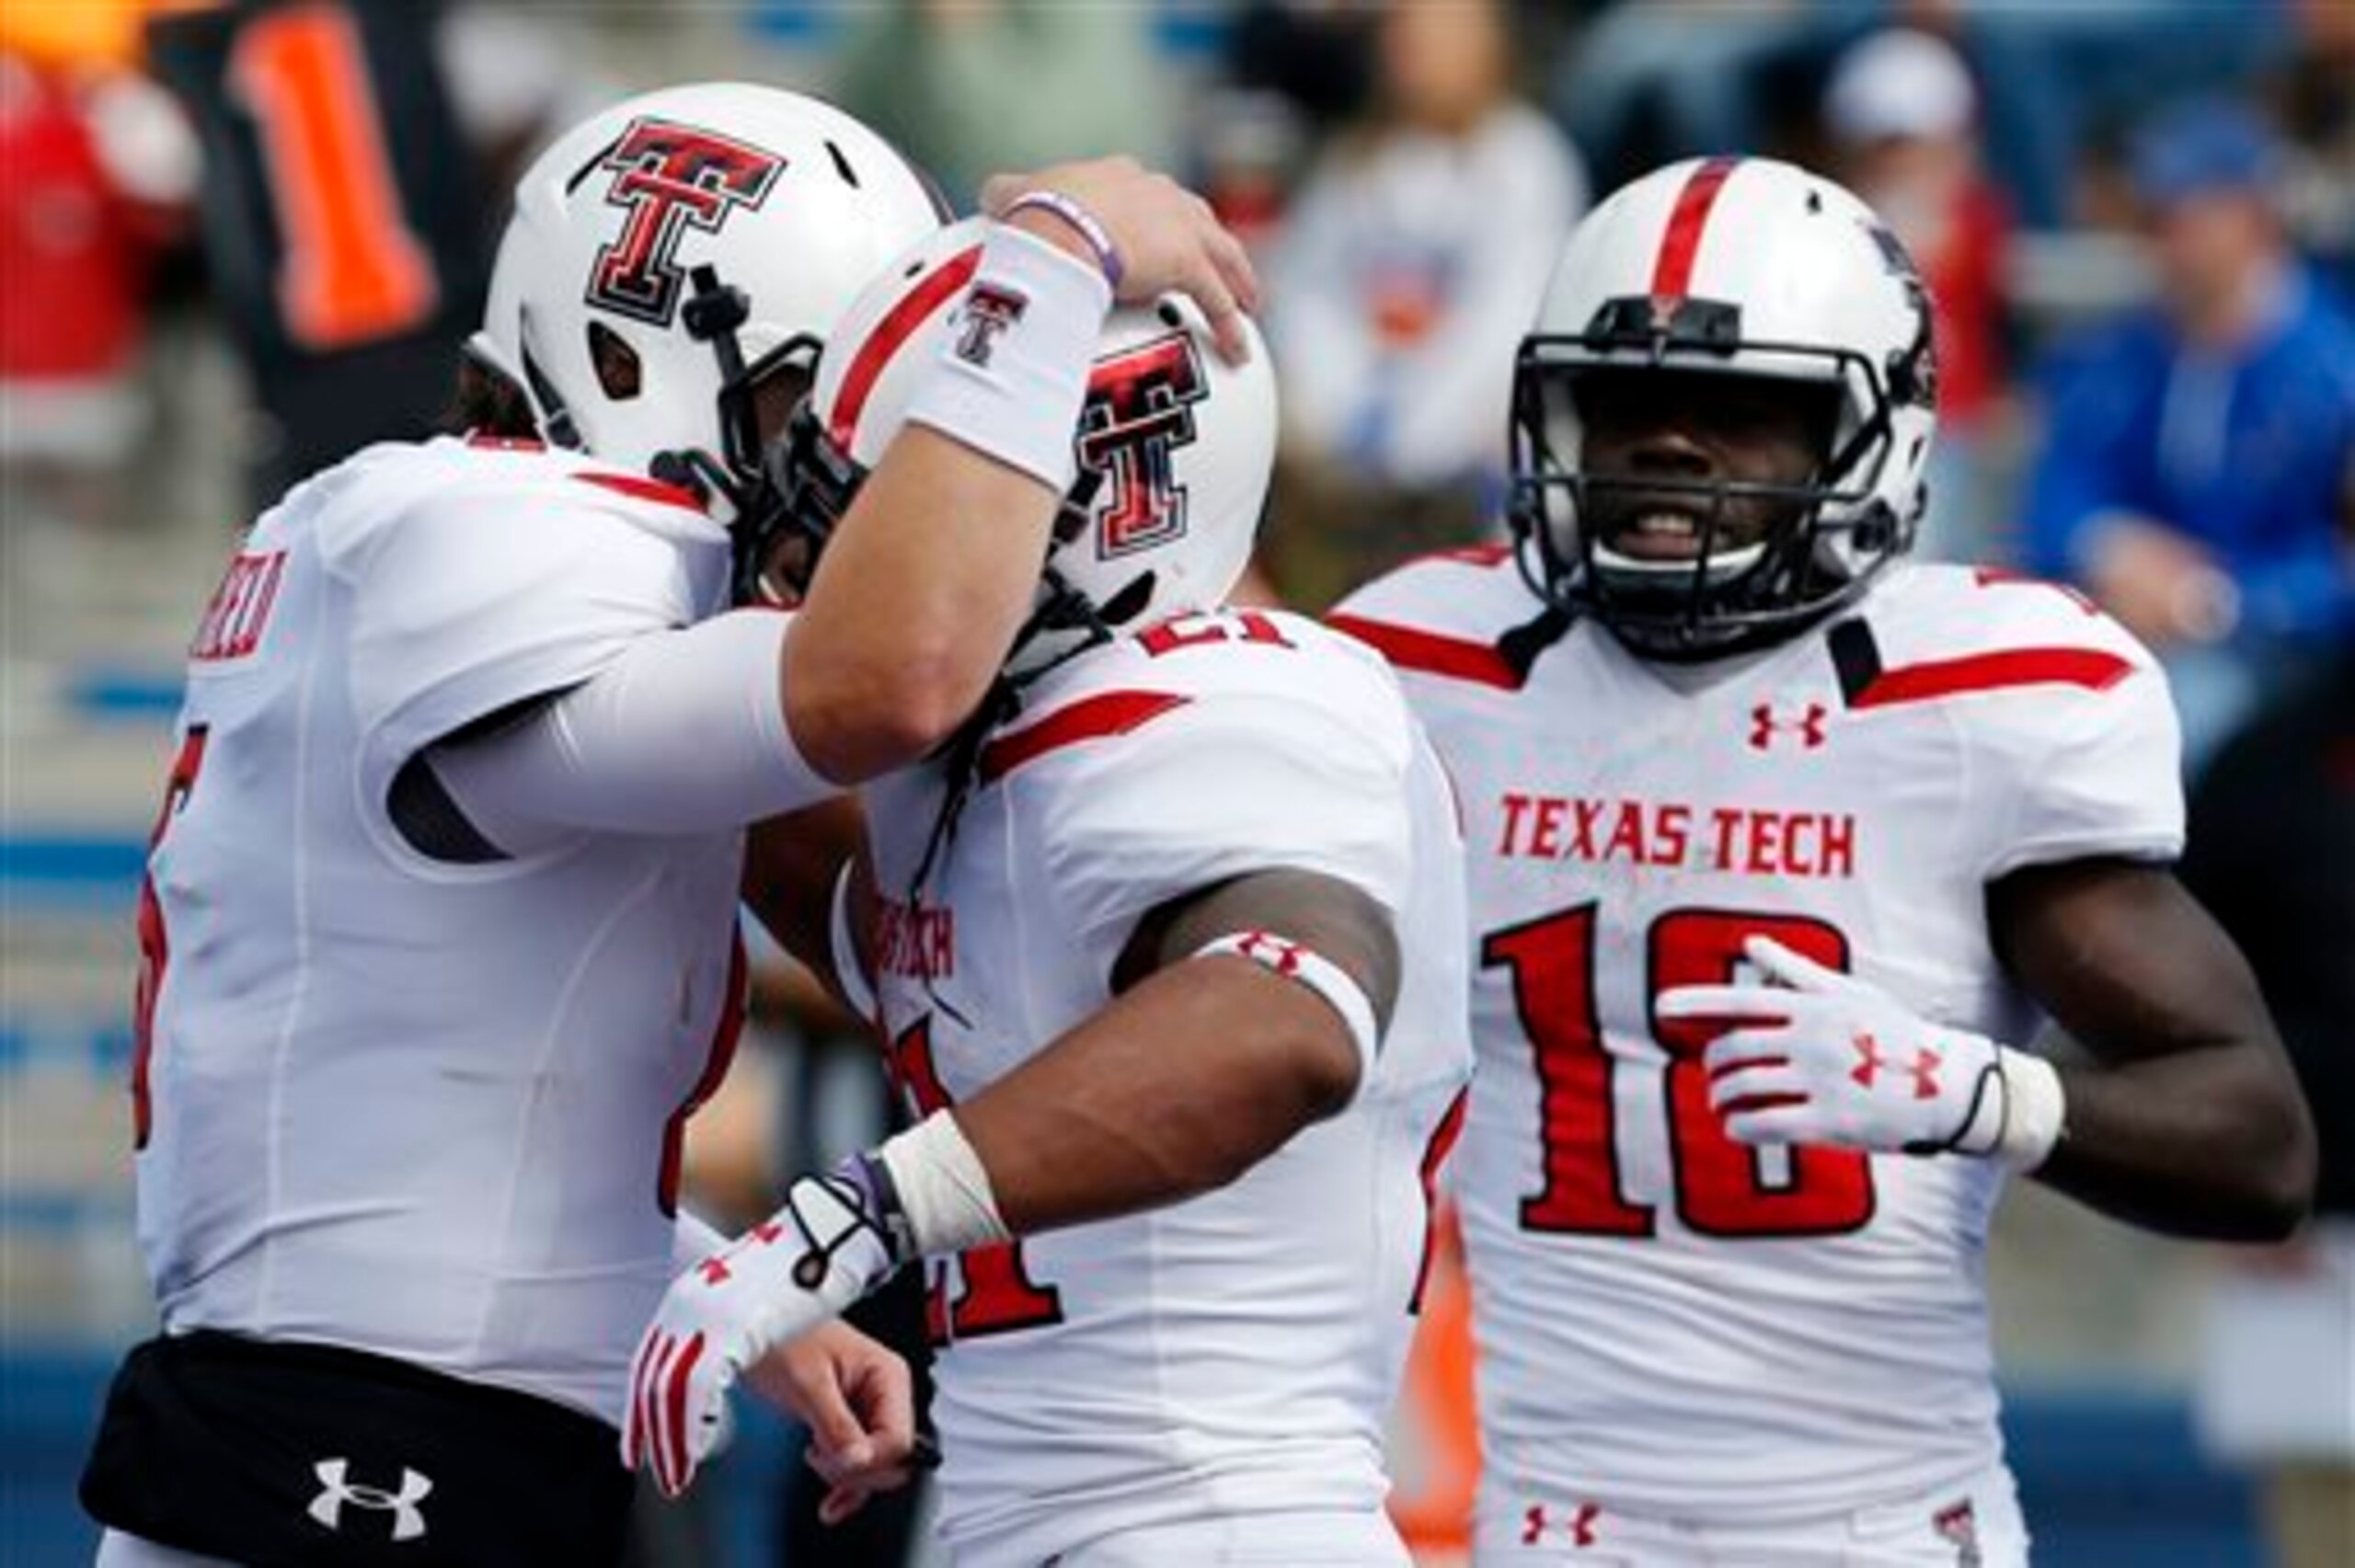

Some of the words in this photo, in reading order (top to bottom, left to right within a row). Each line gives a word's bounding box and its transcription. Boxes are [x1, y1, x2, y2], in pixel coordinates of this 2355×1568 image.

[224, 6, 441, 350] 1
[1497, 794, 1690, 866] TEXAS
[1712, 808, 1855, 878] TECH
